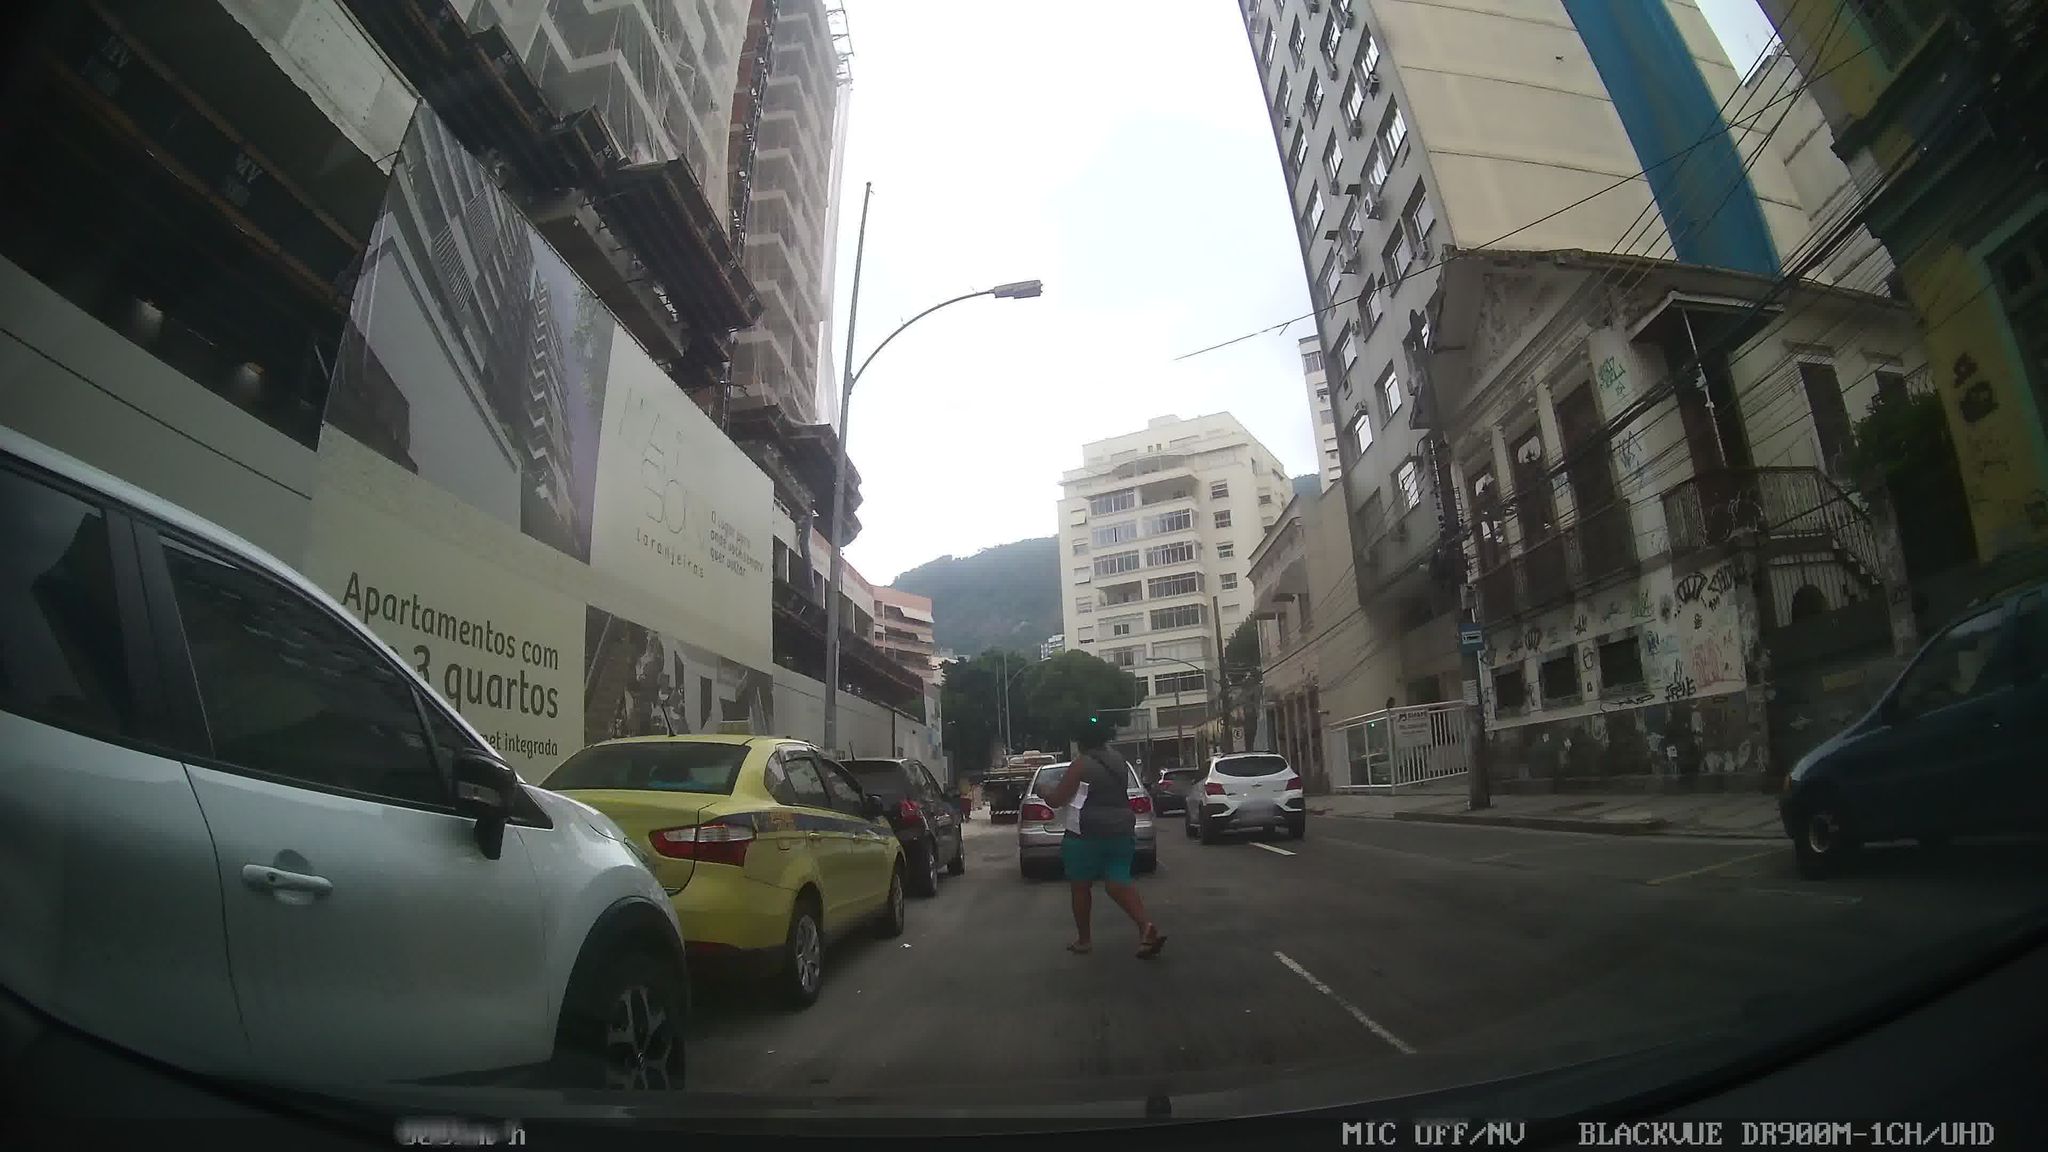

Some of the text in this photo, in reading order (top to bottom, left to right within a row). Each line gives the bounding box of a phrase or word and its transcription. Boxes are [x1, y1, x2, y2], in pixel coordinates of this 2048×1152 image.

[341, 571, 559, 670] Apartamentos com
[444, 663, 559, 719] quartos
[504, 732, 559, 758] integrada
